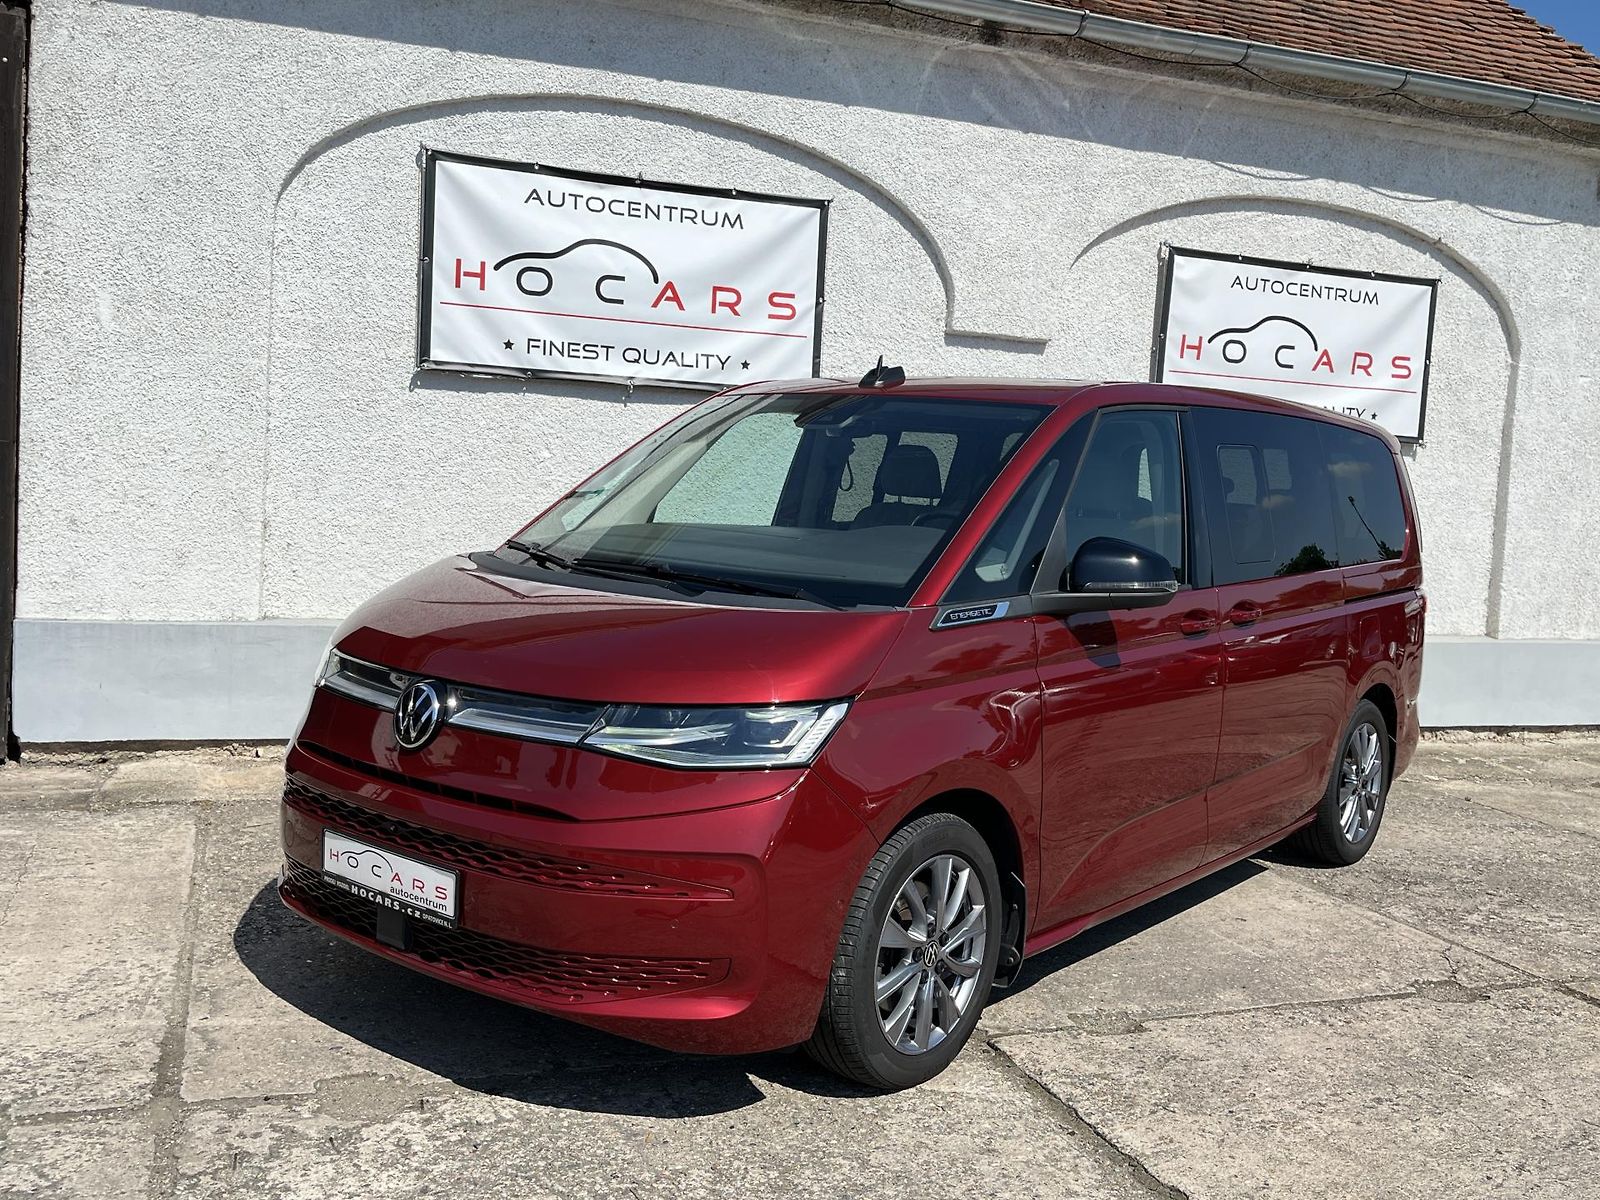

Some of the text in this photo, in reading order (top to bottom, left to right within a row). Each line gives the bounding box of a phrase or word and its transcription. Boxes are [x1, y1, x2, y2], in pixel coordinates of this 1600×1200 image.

[524, 188, 744, 230] AUTOCENTRUM
[1230, 275, 1379, 305] AUTOCENTRUM
[526, 338, 732, 371] FINEST QUALITY
[389, 886, 447, 912] autocentrum
